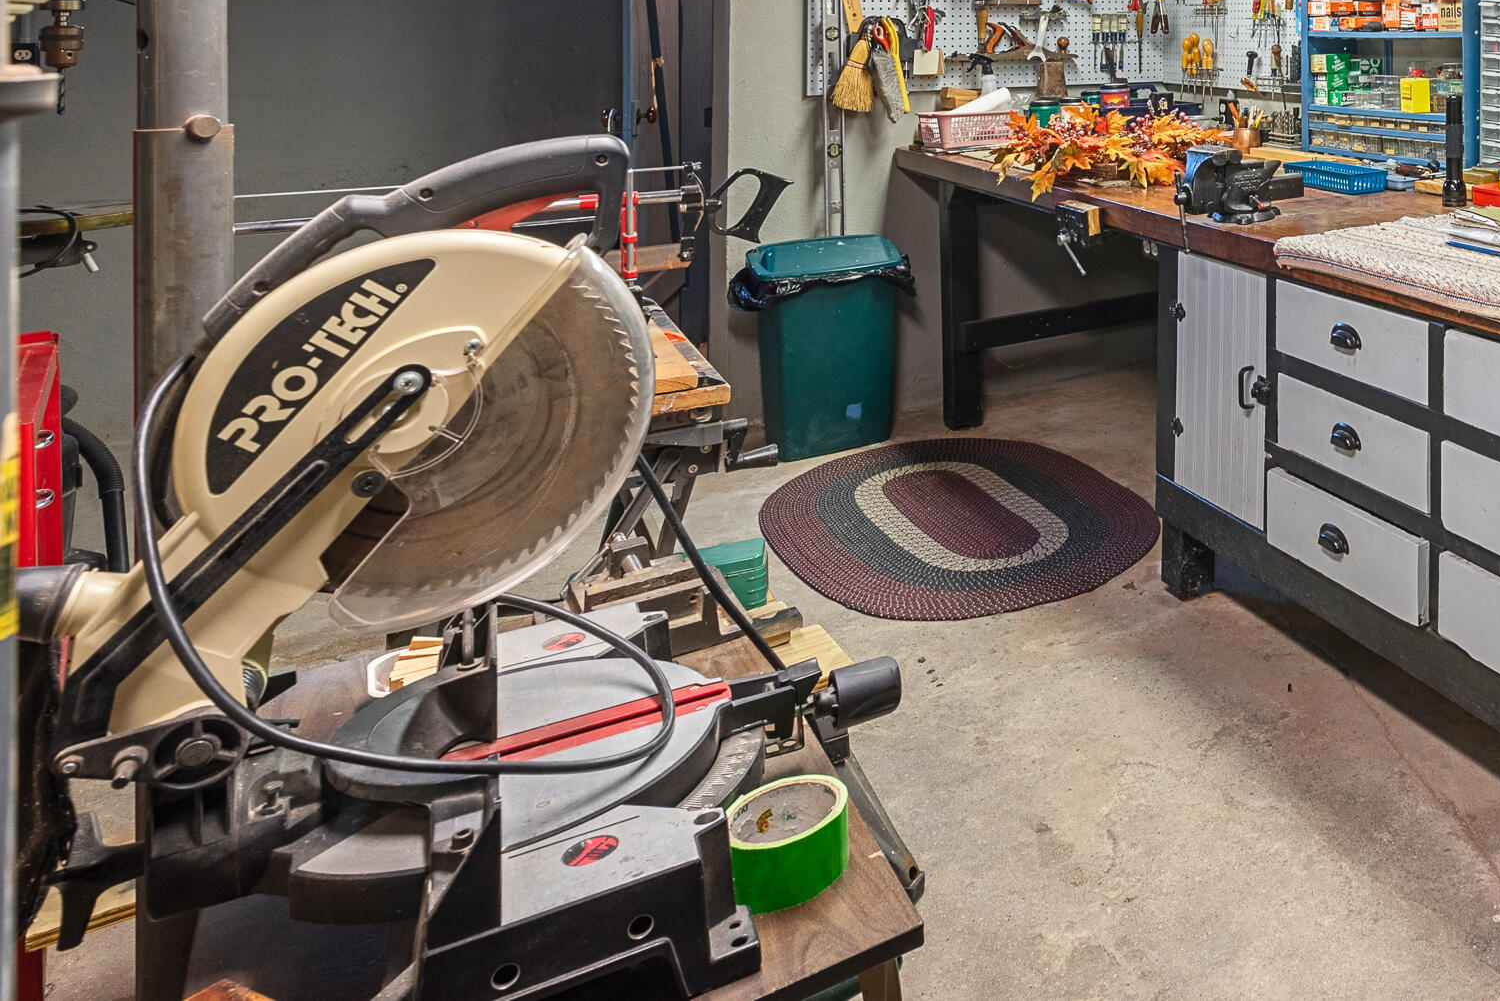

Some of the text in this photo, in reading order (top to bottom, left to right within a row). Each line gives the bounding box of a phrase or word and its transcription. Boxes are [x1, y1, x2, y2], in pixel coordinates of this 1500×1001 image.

[1386, 2, 1400, 22] nails
[1440, 0, 1462, 19] nails
[1422, 13, 1438, 27] nails
[217, 279, 403, 454] PRO-TECH
